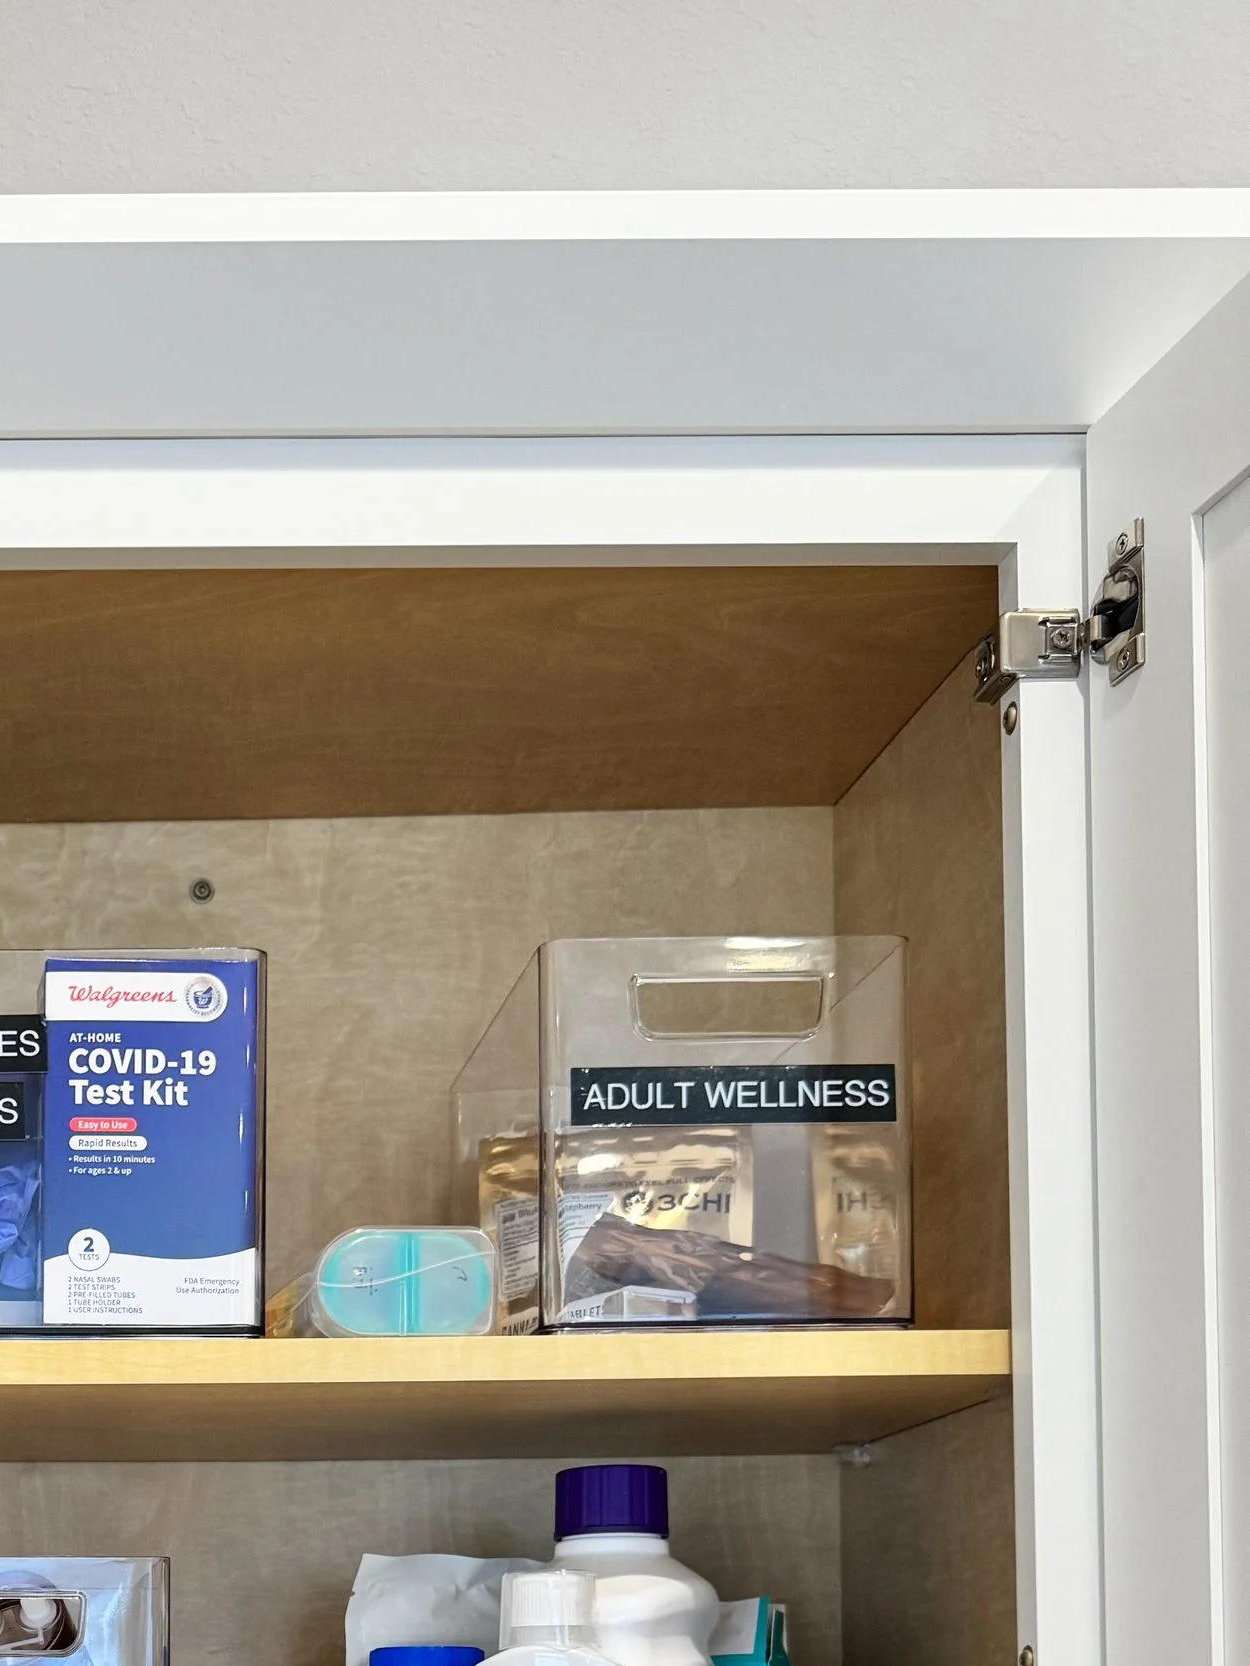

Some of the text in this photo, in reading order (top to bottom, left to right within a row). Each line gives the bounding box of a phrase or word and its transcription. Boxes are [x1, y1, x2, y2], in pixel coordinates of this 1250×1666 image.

[68, 984, 178, 1009] Walgreens
[69, 1032, 122, 1044] AT-HOME
[68, 1048, 218, 1077] COVID-19
[68, 1078, 189, 1107] Test Kit
[582, 1079, 890, 1111] ADULT WELLNESS
[78, 1120, 128, 1131] Easy to Use
[78, 1138, 138, 1149] Rapid Results
[73, 1154, 156, 1164] Results in 10 minutes
[73, 1166, 132, 1176] For ages 2 & up
[83, 1236, 95, 1253] 2
